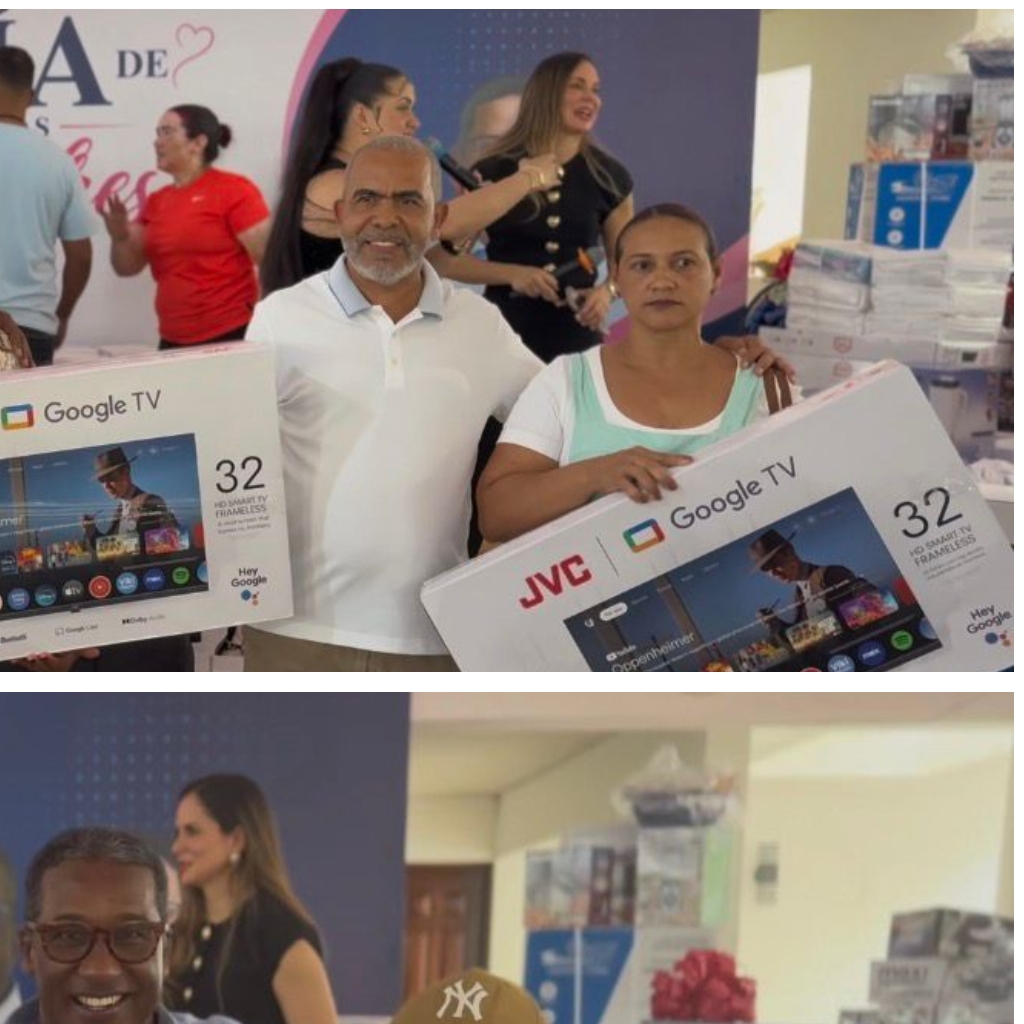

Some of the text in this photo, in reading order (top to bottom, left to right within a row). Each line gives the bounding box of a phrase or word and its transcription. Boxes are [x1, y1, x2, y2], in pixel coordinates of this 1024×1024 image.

[117, 49, 168, 78] DE
[44, 394, 127, 424] Google
[131, 390, 162, 412] TV
[215, 456, 265, 493] 32
[215, 503, 267, 518] FRAMELESS
[894, 487, 963, 538] 32
[519, 456, 797, 609] JVC Google TV
[908, 546, 925, 558] HD
[925, 530, 958, 550] SMART
[914, 534, 977, 567] FRAMELESS
[230, 575, 267, 588] Google
[238, 566, 258, 577] Hey
[966, 610, 1013, 635] Google
[969, 605, 996, 621] Hey
[436, 979, 488, 1021] NY
